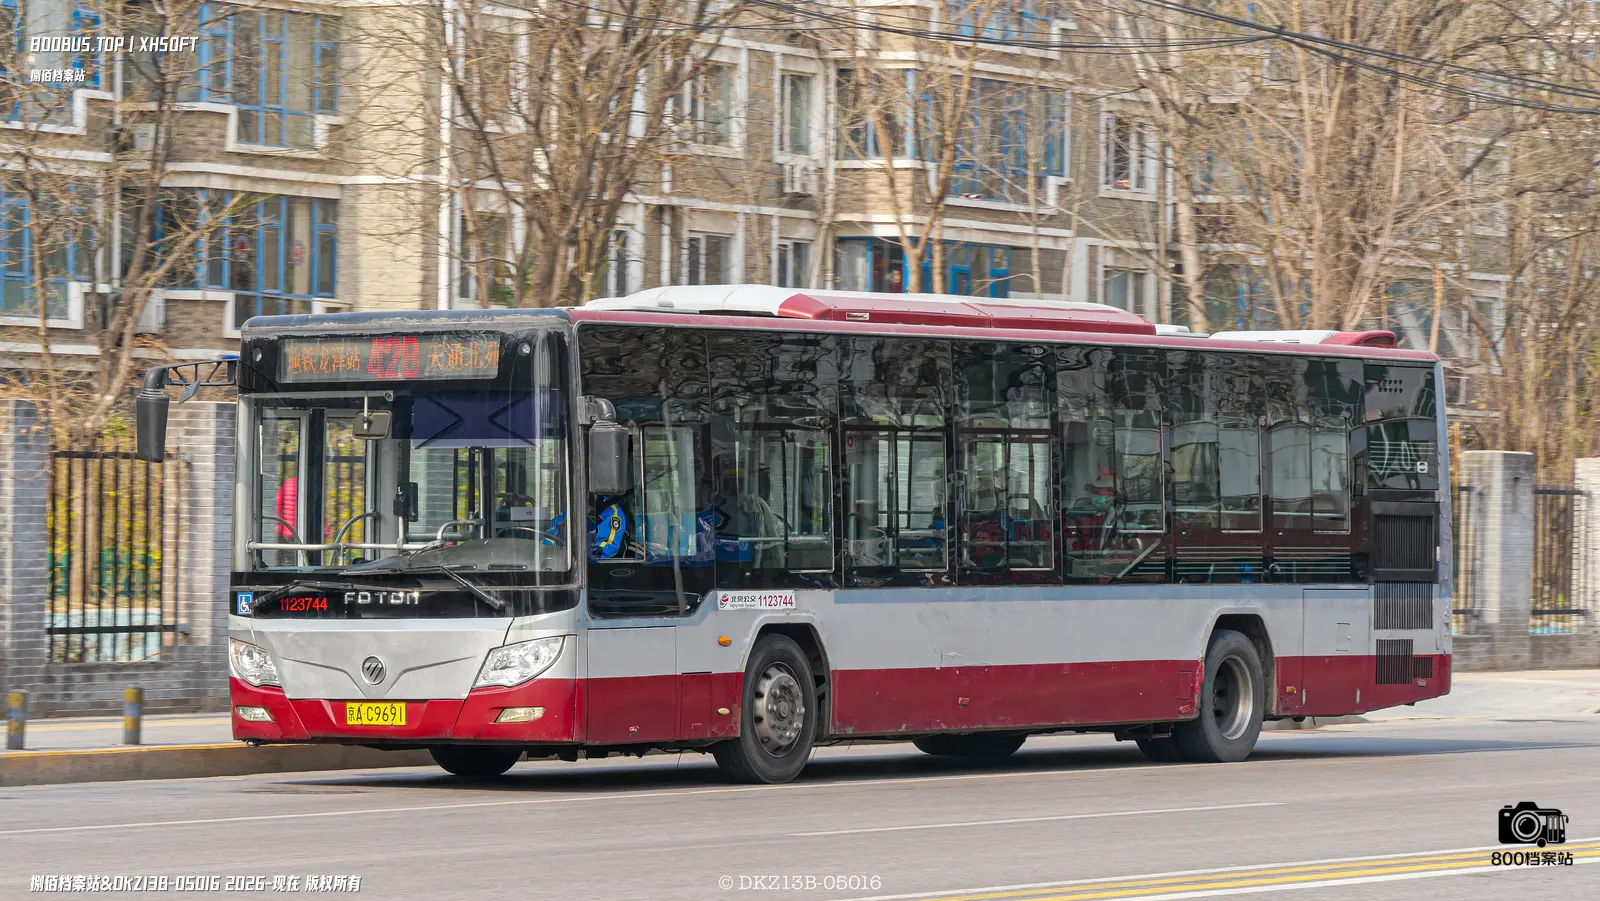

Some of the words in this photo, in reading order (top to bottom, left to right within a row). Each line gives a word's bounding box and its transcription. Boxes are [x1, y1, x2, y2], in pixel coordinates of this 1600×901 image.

[286, 346, 361, 375] 地铁龙泽站
[367, 337, 420, 379] 428
[280, 597, 328, 611] 1123744
[344, 591, 419, 605] FOTON
[730, 595, 756, 603] 北京公交
[758, 595, 793, 607] 1123744
